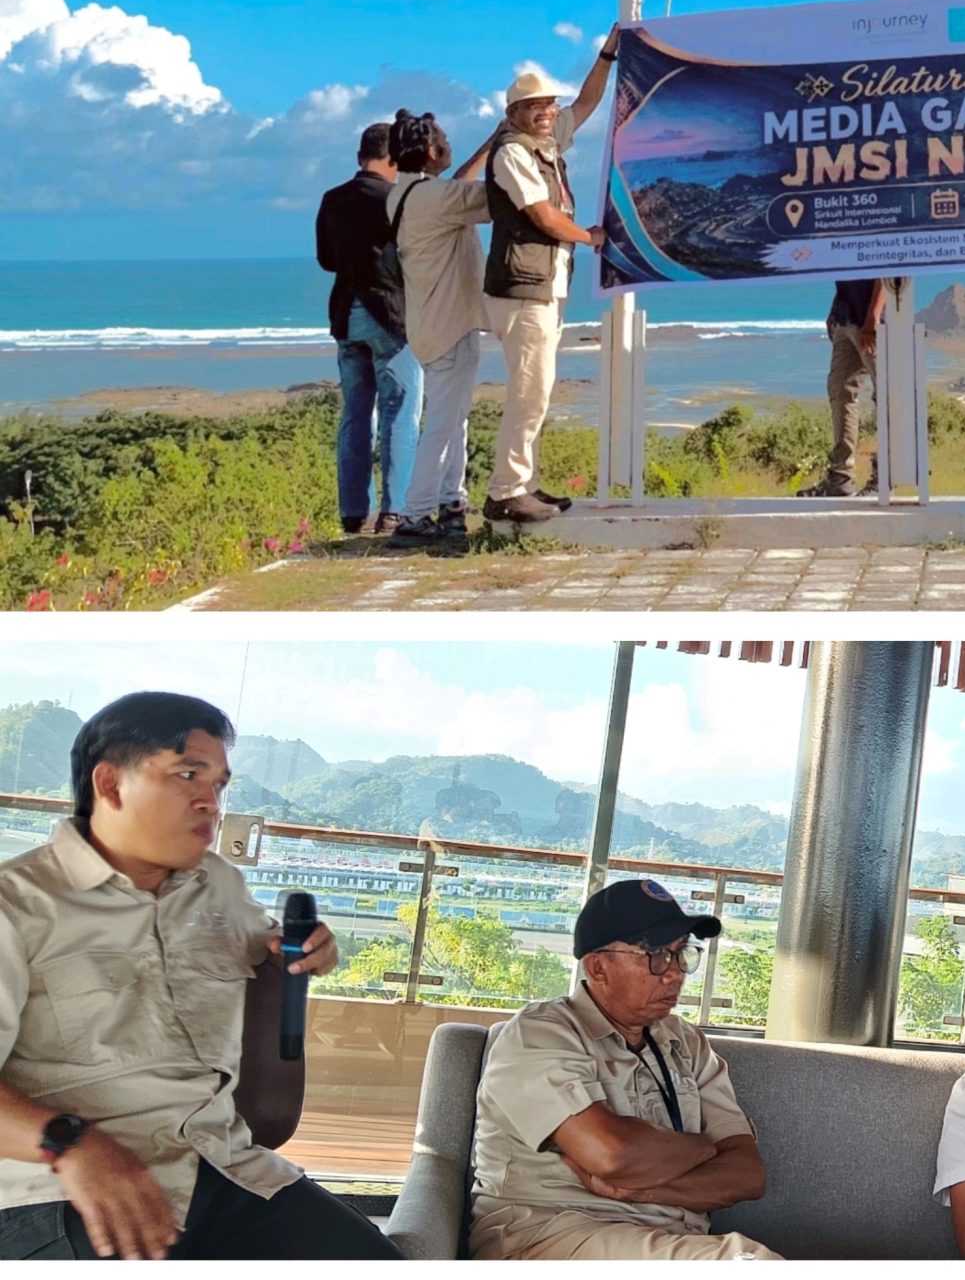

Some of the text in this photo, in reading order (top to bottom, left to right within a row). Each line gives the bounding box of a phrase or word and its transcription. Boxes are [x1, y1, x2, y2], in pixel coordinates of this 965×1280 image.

[763, 101, 907, 145] MEDIA
[780, 139, 908, 187] JMSI
[814, 193, 878, 208] Bukit 360
[814, 209, 843, 219] Sirkuit
[831, 237, 900, 251] Memperkuat
[903, 234, 960, 246] Ekosistem
[857, 249, 933, 262] Berintegritas,
[935, 247, 957, 257] dan
